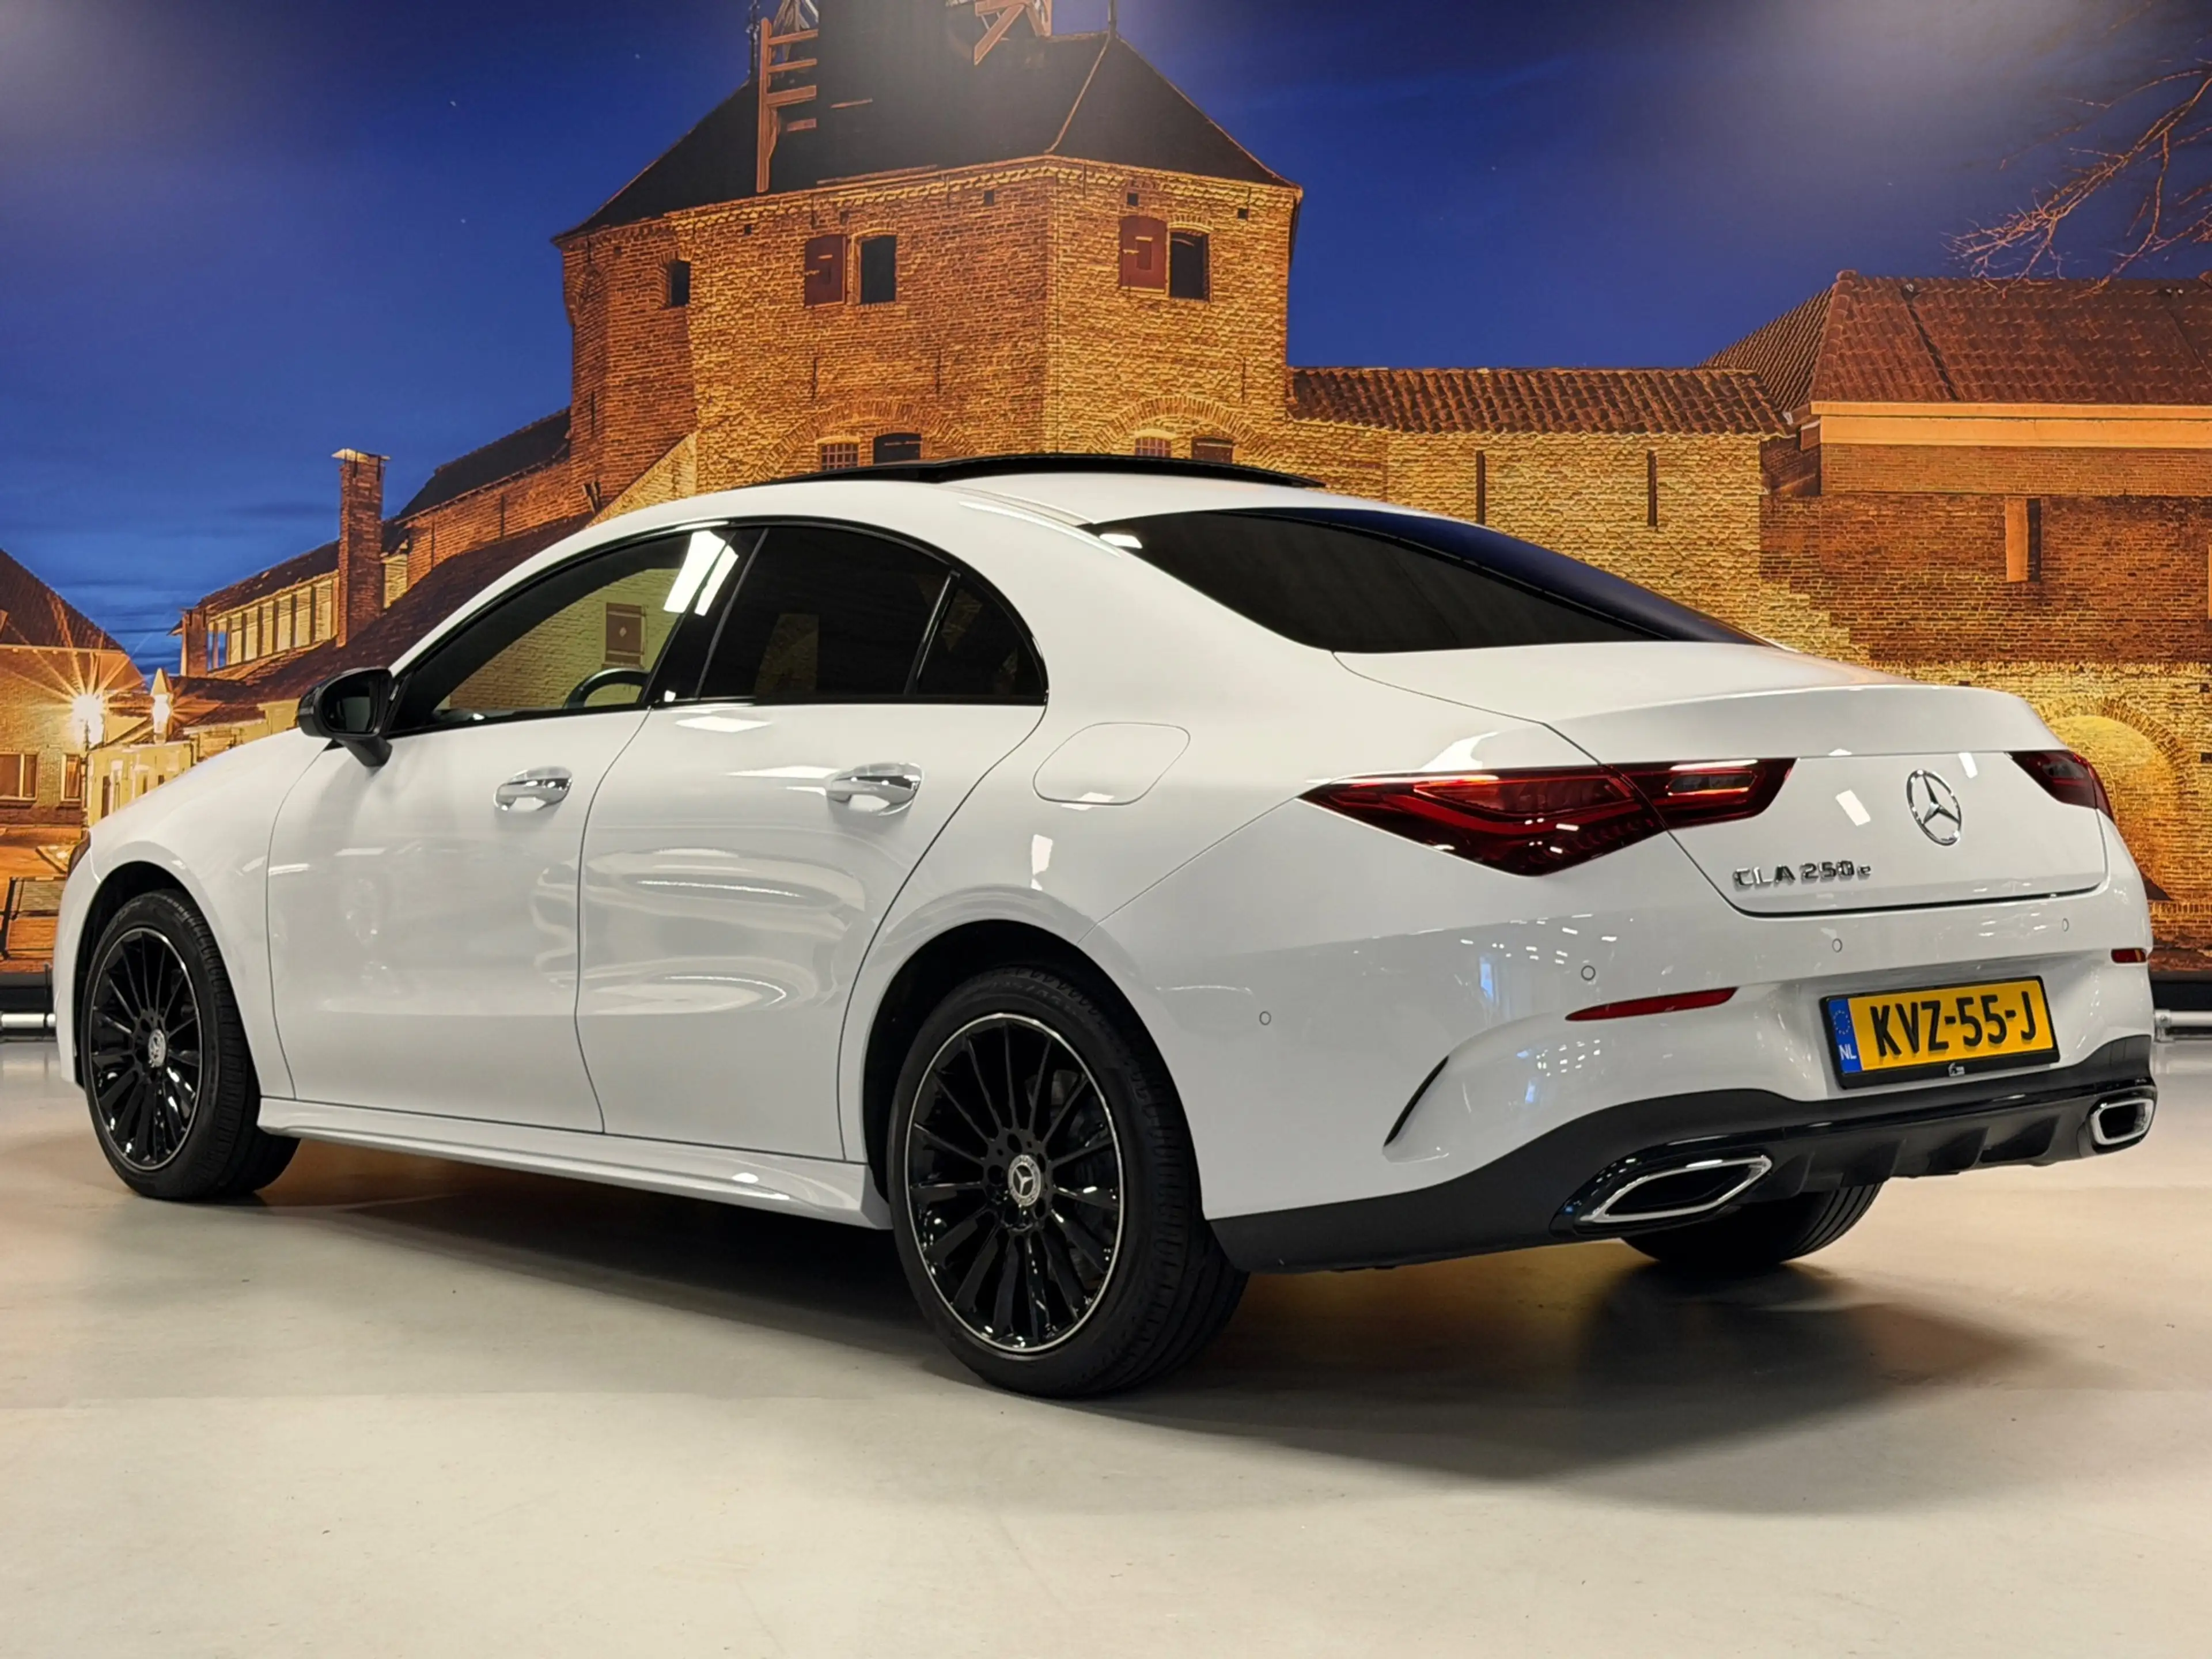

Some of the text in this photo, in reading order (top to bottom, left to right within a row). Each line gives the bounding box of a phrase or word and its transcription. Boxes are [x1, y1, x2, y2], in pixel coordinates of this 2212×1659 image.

[1732, 864, 1796, 887] CLA
[1869, 991, 2036, 1058] KVZ-55-J
[1839, 1044, 1857, 1061] NL
